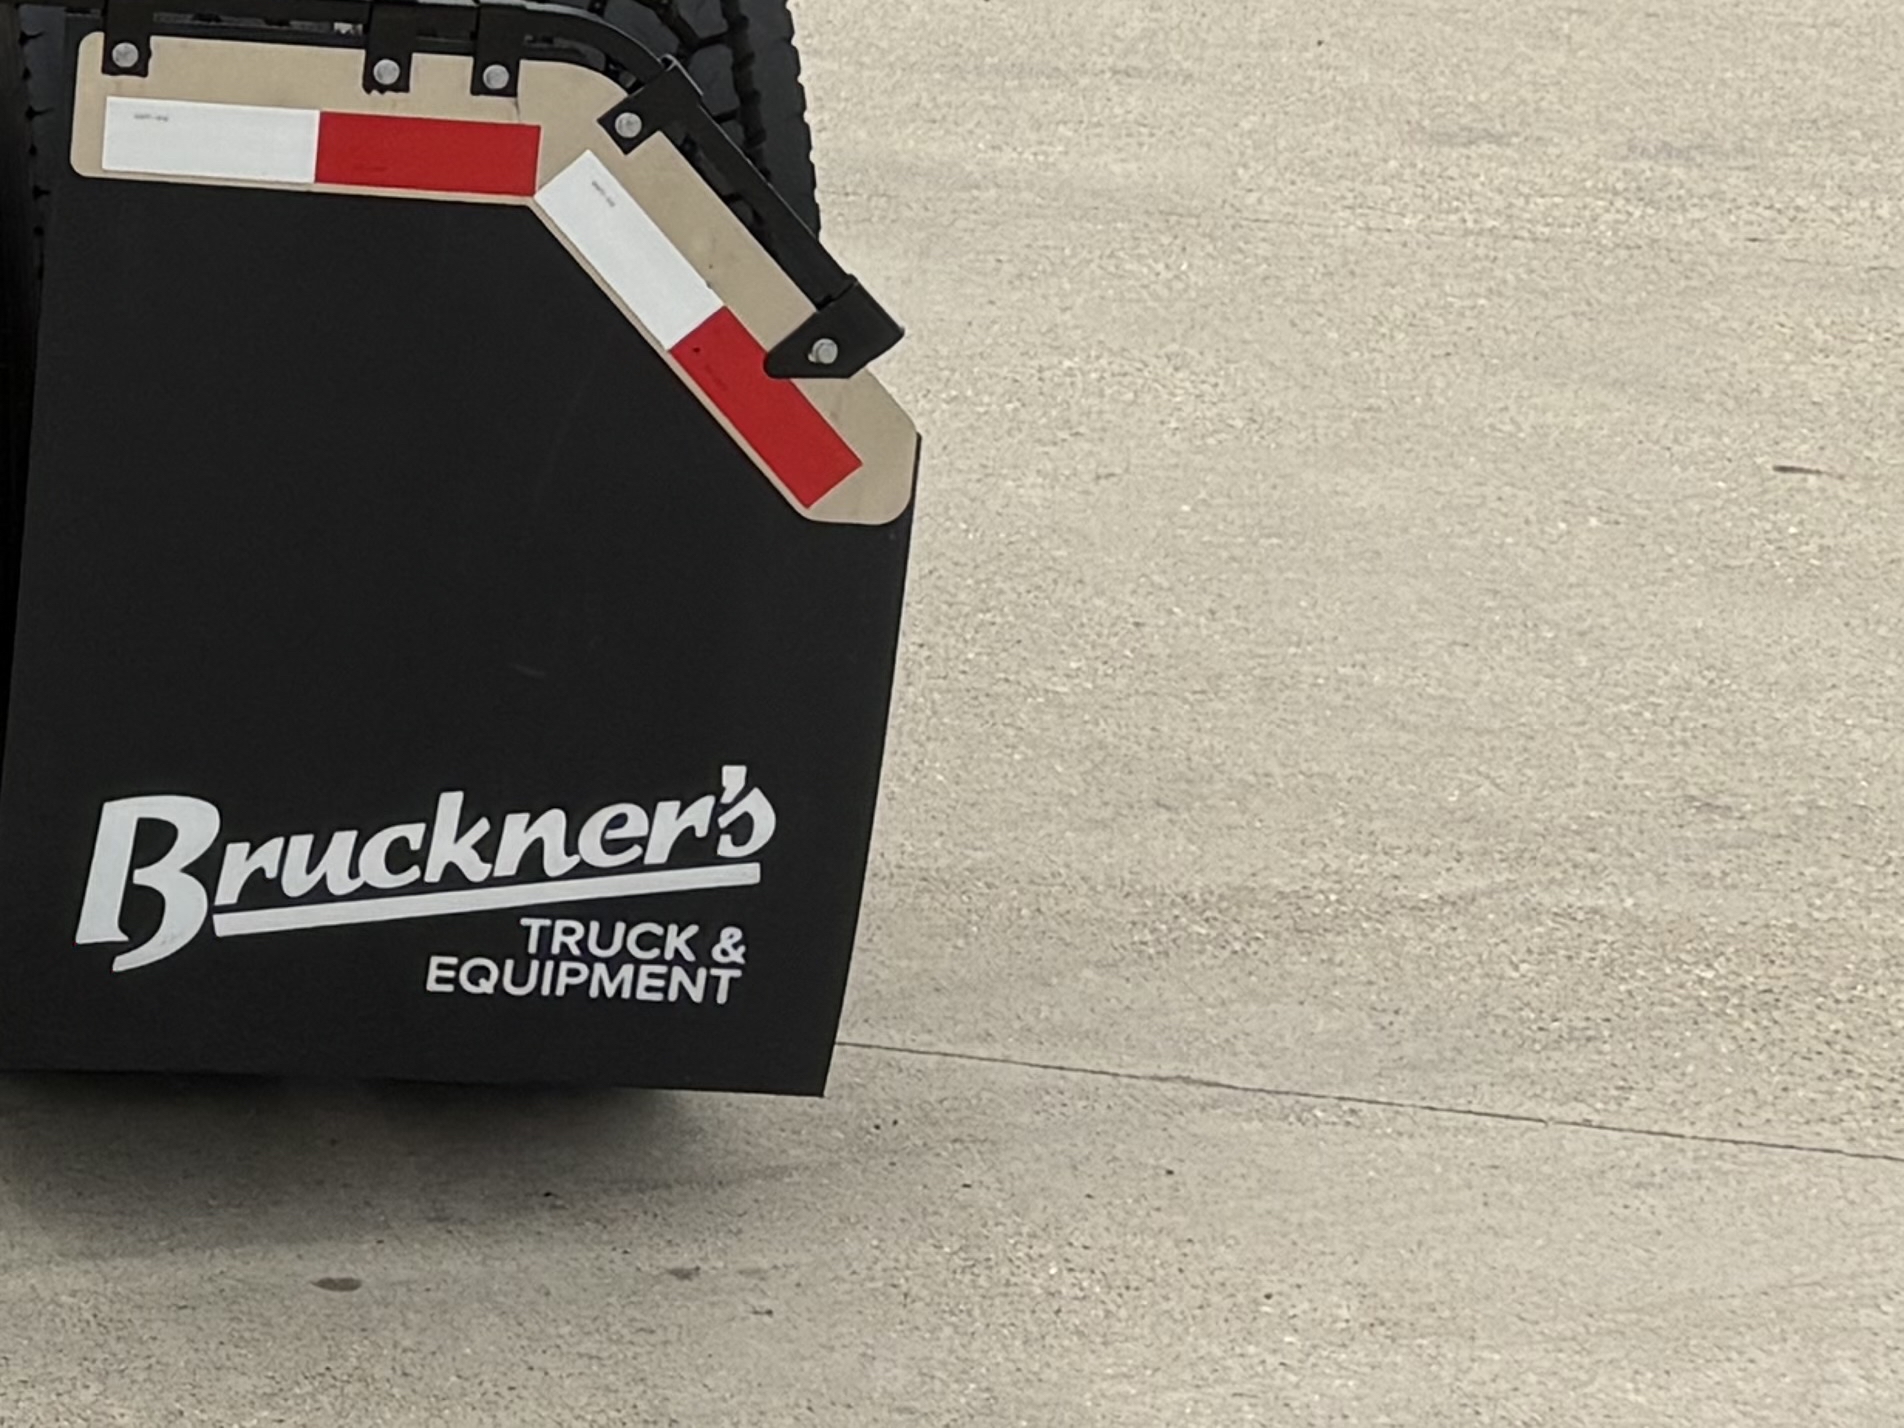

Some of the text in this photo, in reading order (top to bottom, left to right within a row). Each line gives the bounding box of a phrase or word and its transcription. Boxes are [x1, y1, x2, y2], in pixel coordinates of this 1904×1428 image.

[76, 765, 776, 971] Bruckner's
[520, 918, 745, 964] TRUCK &
[427, 955, 742, 1004] EQUIPMENT
